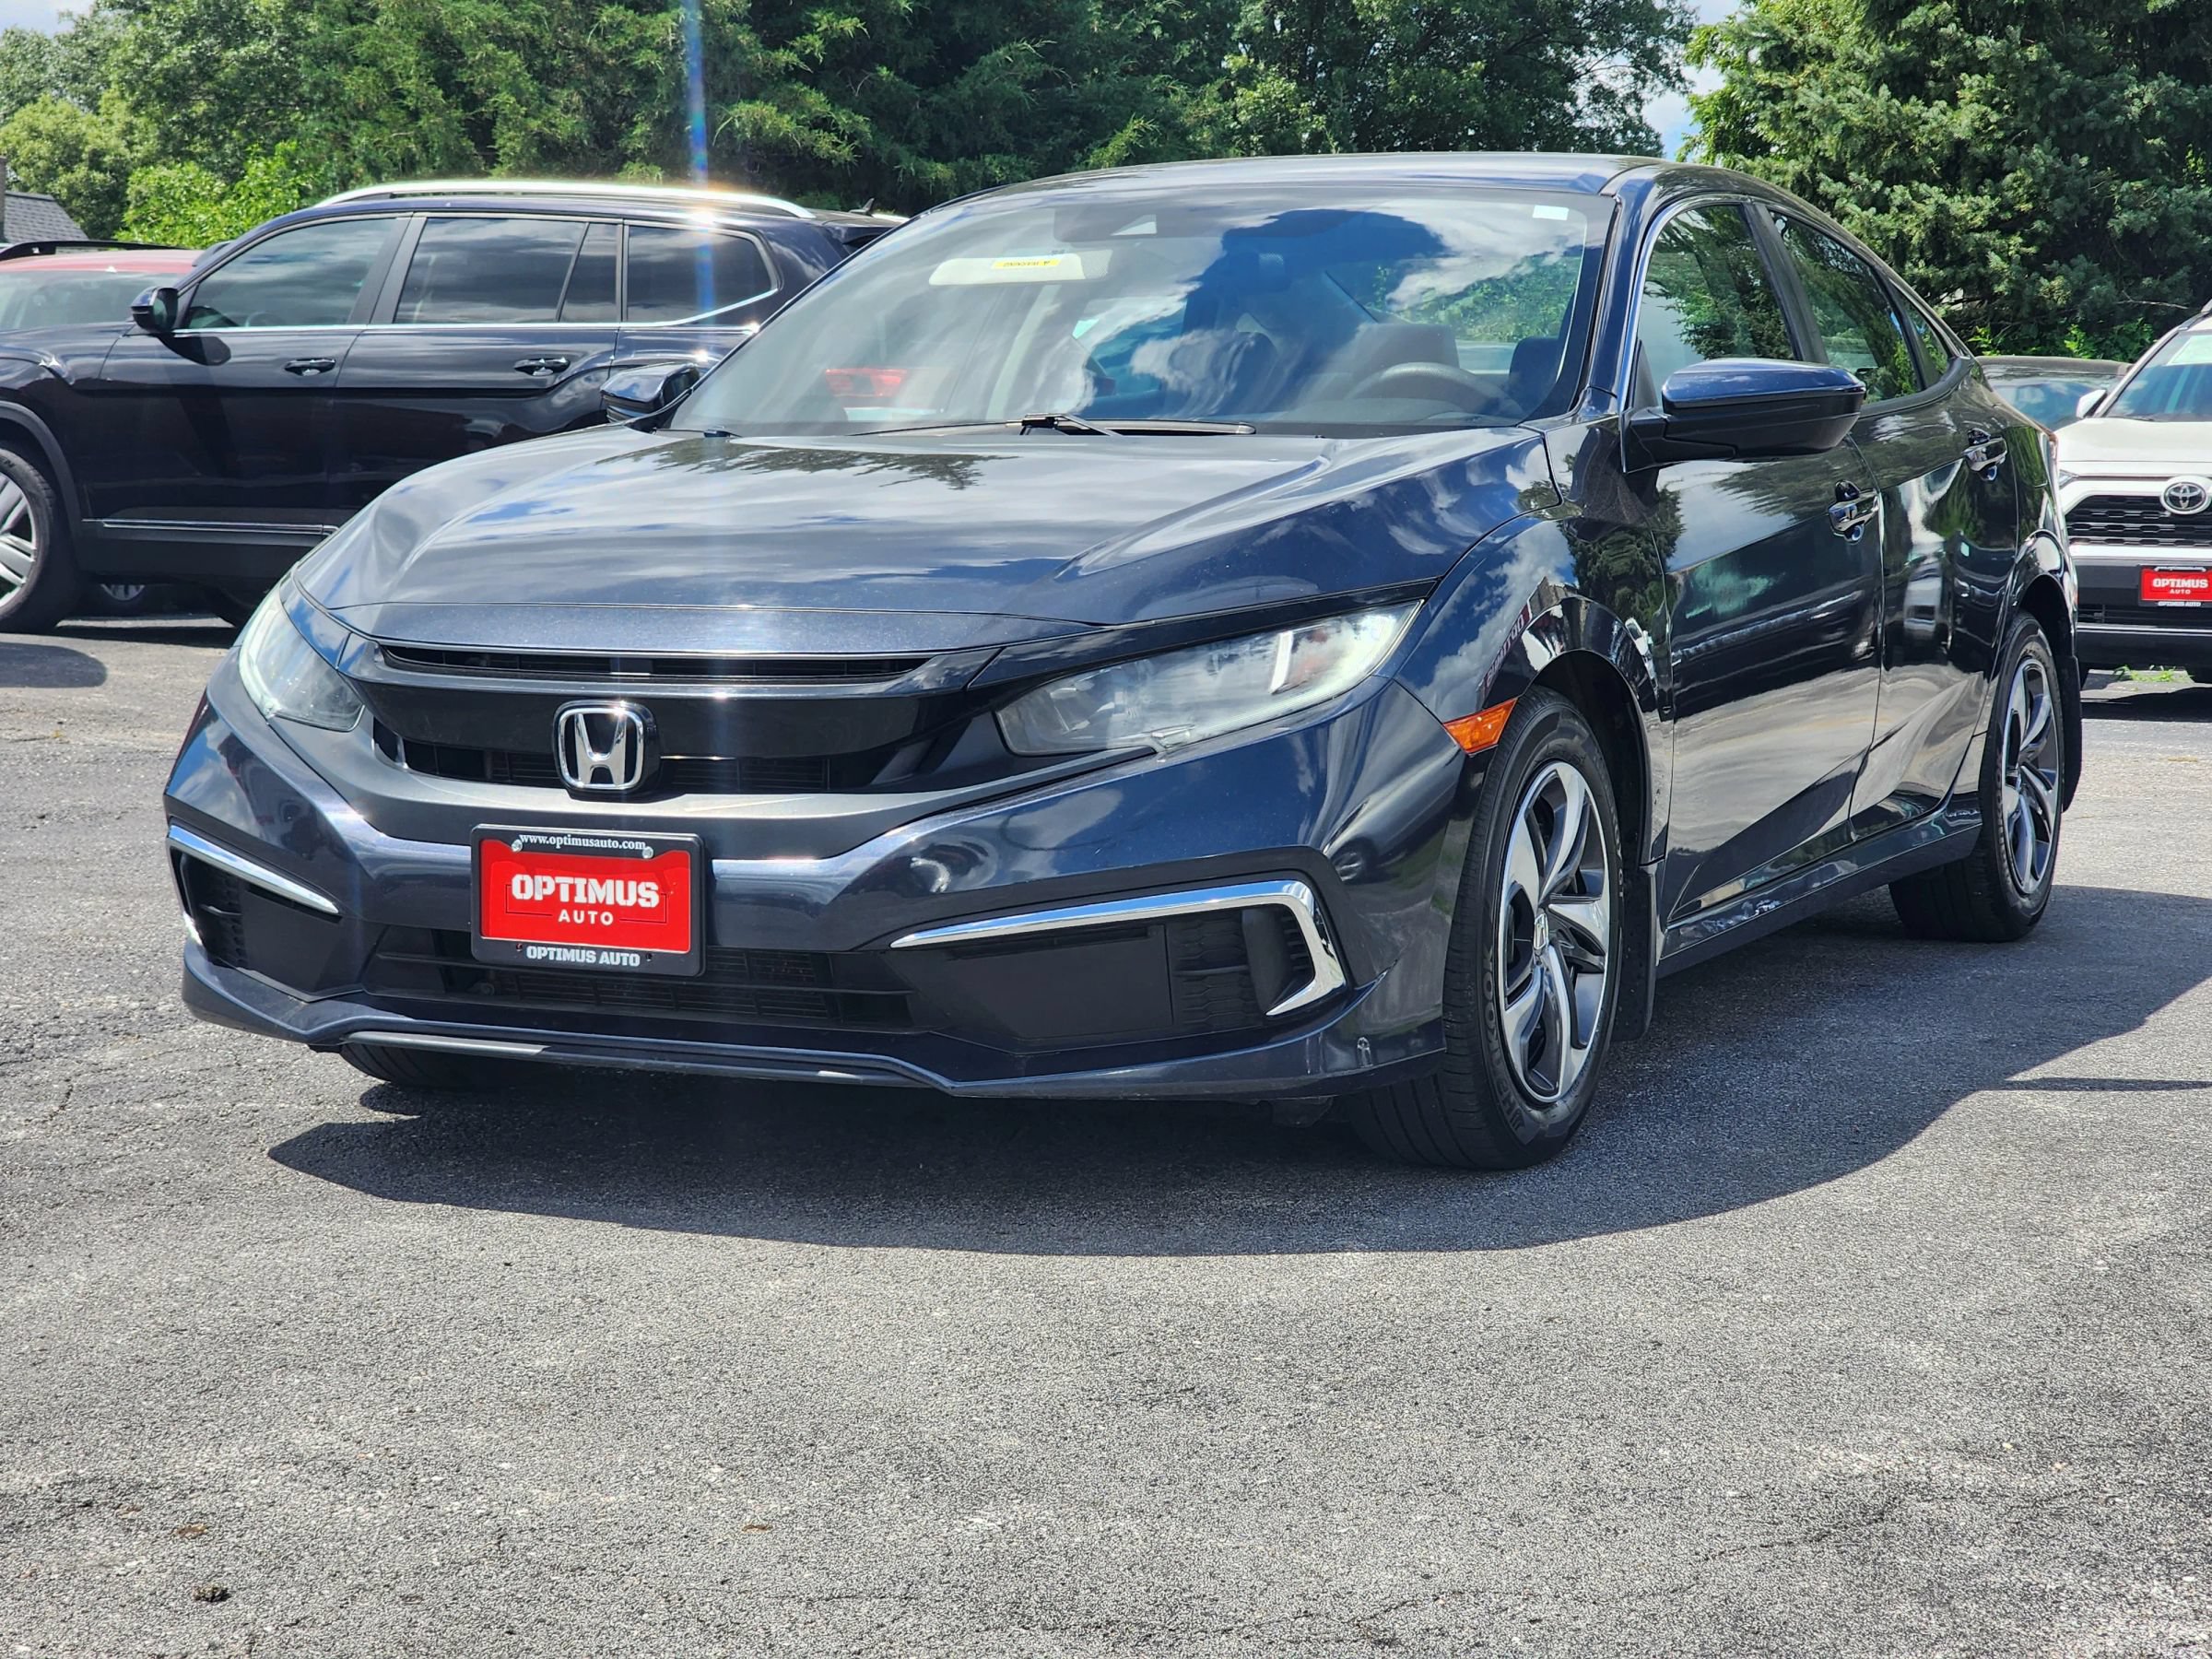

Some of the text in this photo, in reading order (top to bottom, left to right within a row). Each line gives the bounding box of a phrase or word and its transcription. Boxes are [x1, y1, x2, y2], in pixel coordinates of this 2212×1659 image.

[2153, 579, 2208, 589] OPTIMUS
[519, 834, 646, 850] www.optimusauto.com
[512, 875, 660, 908] OPTIMUS
[559, 910, 614, 925] AUTO
[526, 947, 641, 967] OPTIMUS AUTO
